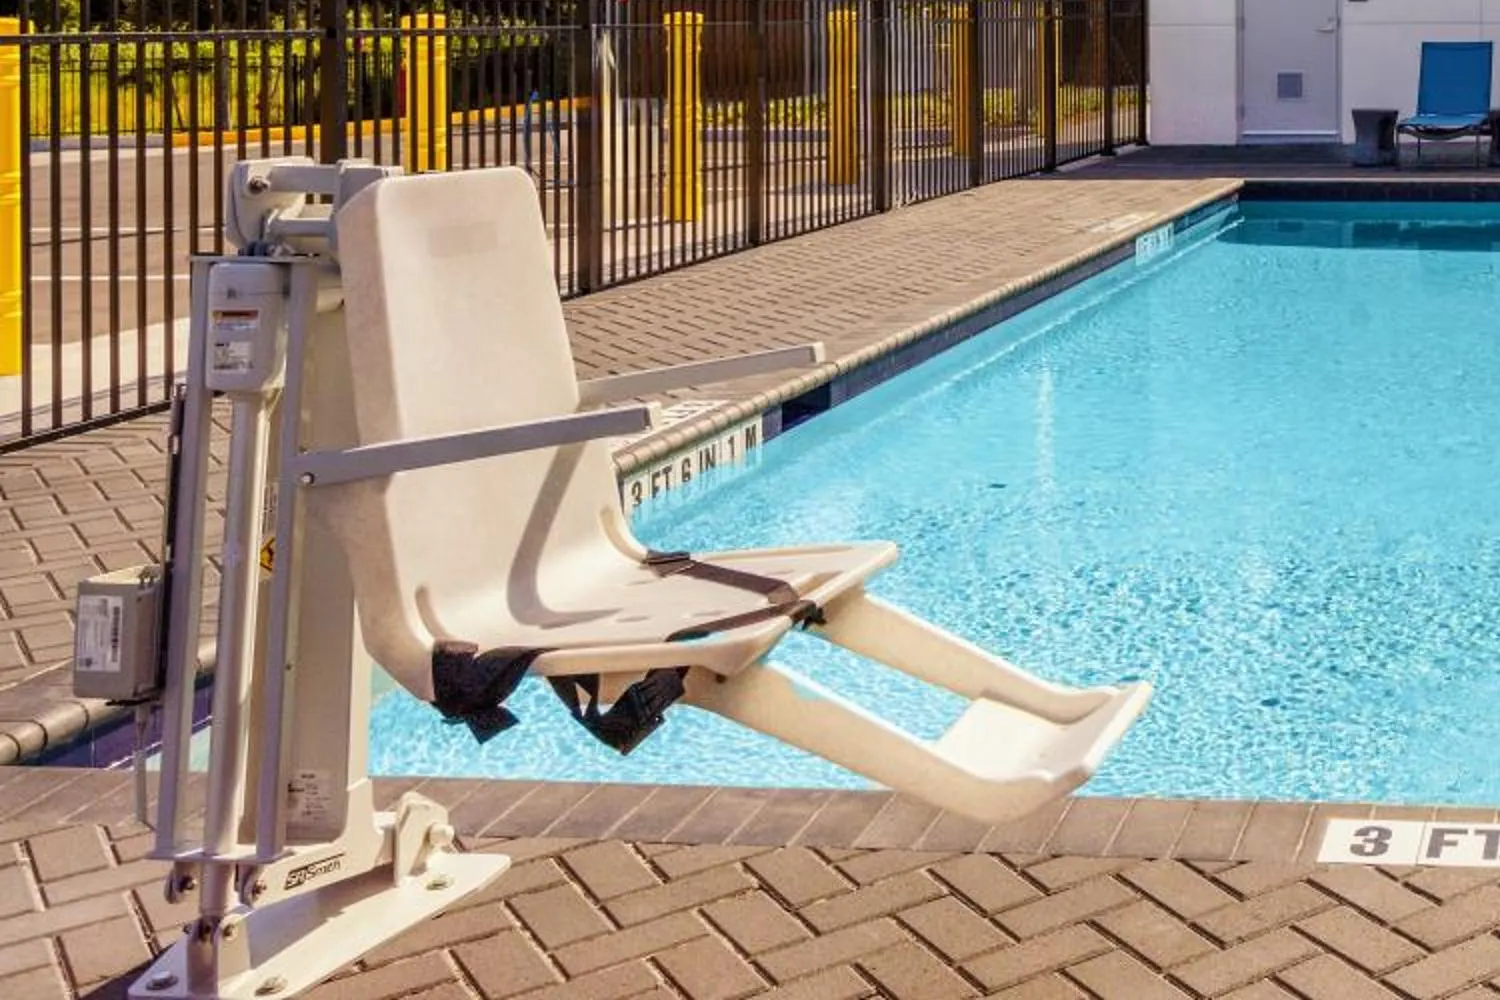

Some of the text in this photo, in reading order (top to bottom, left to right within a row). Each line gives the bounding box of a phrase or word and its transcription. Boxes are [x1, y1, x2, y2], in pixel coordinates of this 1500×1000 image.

[631, 481, 643, 507] 3
[651, 465, 672, 498] FT
[699, 443, 717, 473] IN
[727, 435, 736, 460] 1
[745, 423, 757, 451] M
[1349, 825, 1393, 857] 3
